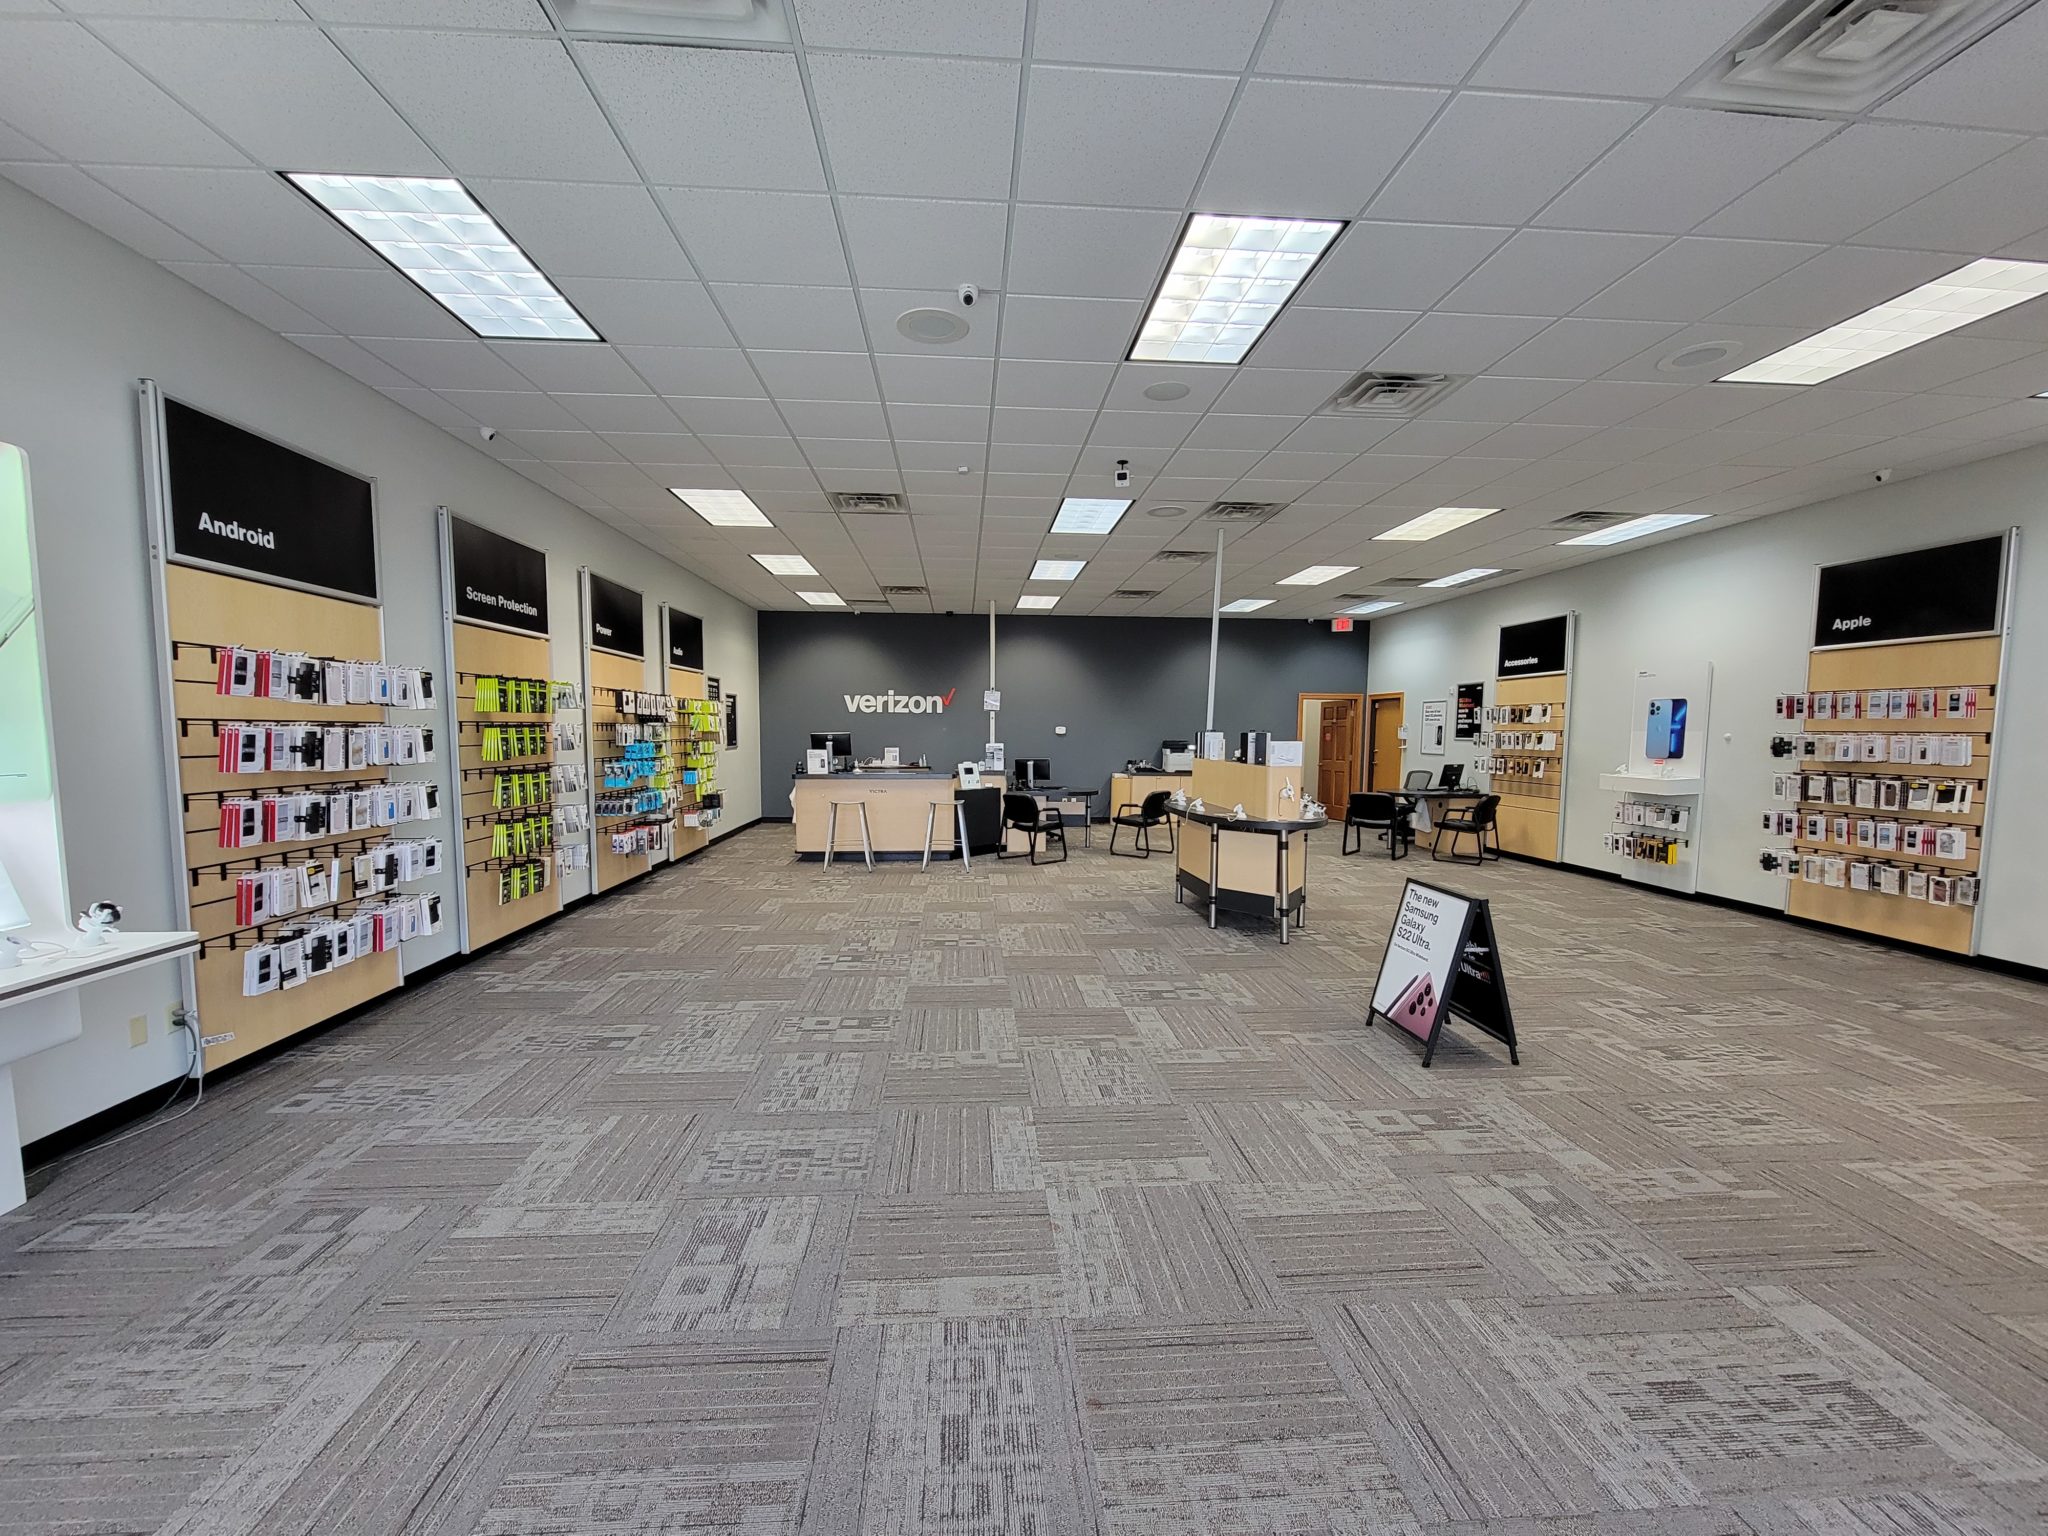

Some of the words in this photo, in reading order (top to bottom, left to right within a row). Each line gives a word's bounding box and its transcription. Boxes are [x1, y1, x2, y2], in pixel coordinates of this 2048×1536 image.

[198, 512, 275, 549] Android
[466, 586, 497, 607] Screen
[498, 595, 538, 617] Protection
[595, 623, 612, 637] Power
[1832, 615, 1872, 631] Apple
[1504, 656, 1539, 668] Accessories
[843, 689, 943, 714] verizon
[1410, 888, 1422, 902] The
[1422, 896, 1439, 908] new
[1404, 901, 1439, 926] Samsung
[1400, 914, 1426, 935] Galaxy
[1397, 926, 1412, 941] S22
[1411, 932, 1431, 951] Ultra.
[1460, 961, 1481, 980] Ultra
